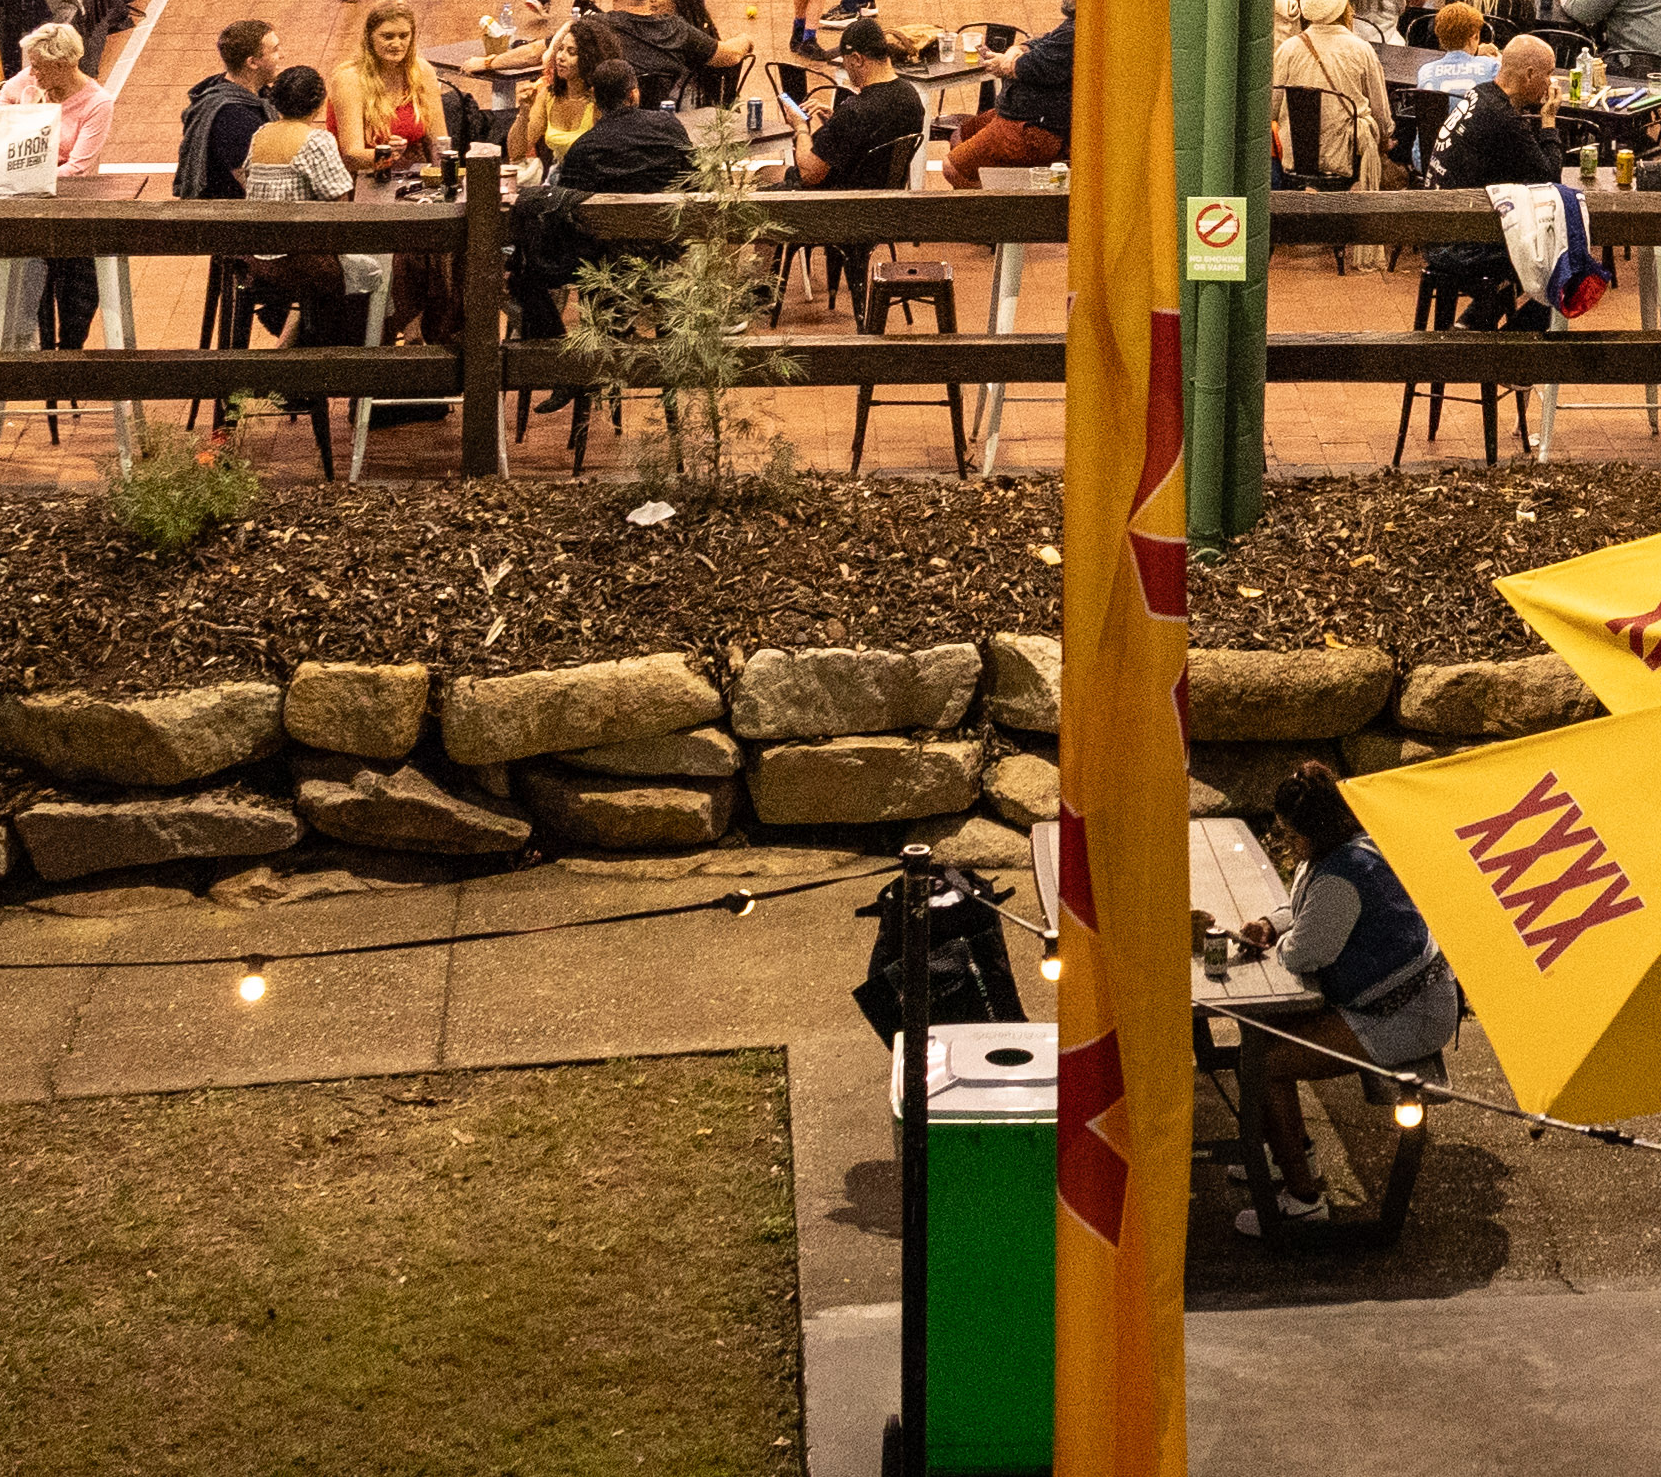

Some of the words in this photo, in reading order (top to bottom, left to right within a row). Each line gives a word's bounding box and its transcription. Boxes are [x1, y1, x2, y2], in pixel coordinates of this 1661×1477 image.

[1435, 61, 1486, 77] BRUYNE
[8, 136, 49, 159] BYRON
[7, 158, 25, 171] BEEF
[1189, 255, 1202, 263] NO
[1454, 769, 1646, 973] XXXX
